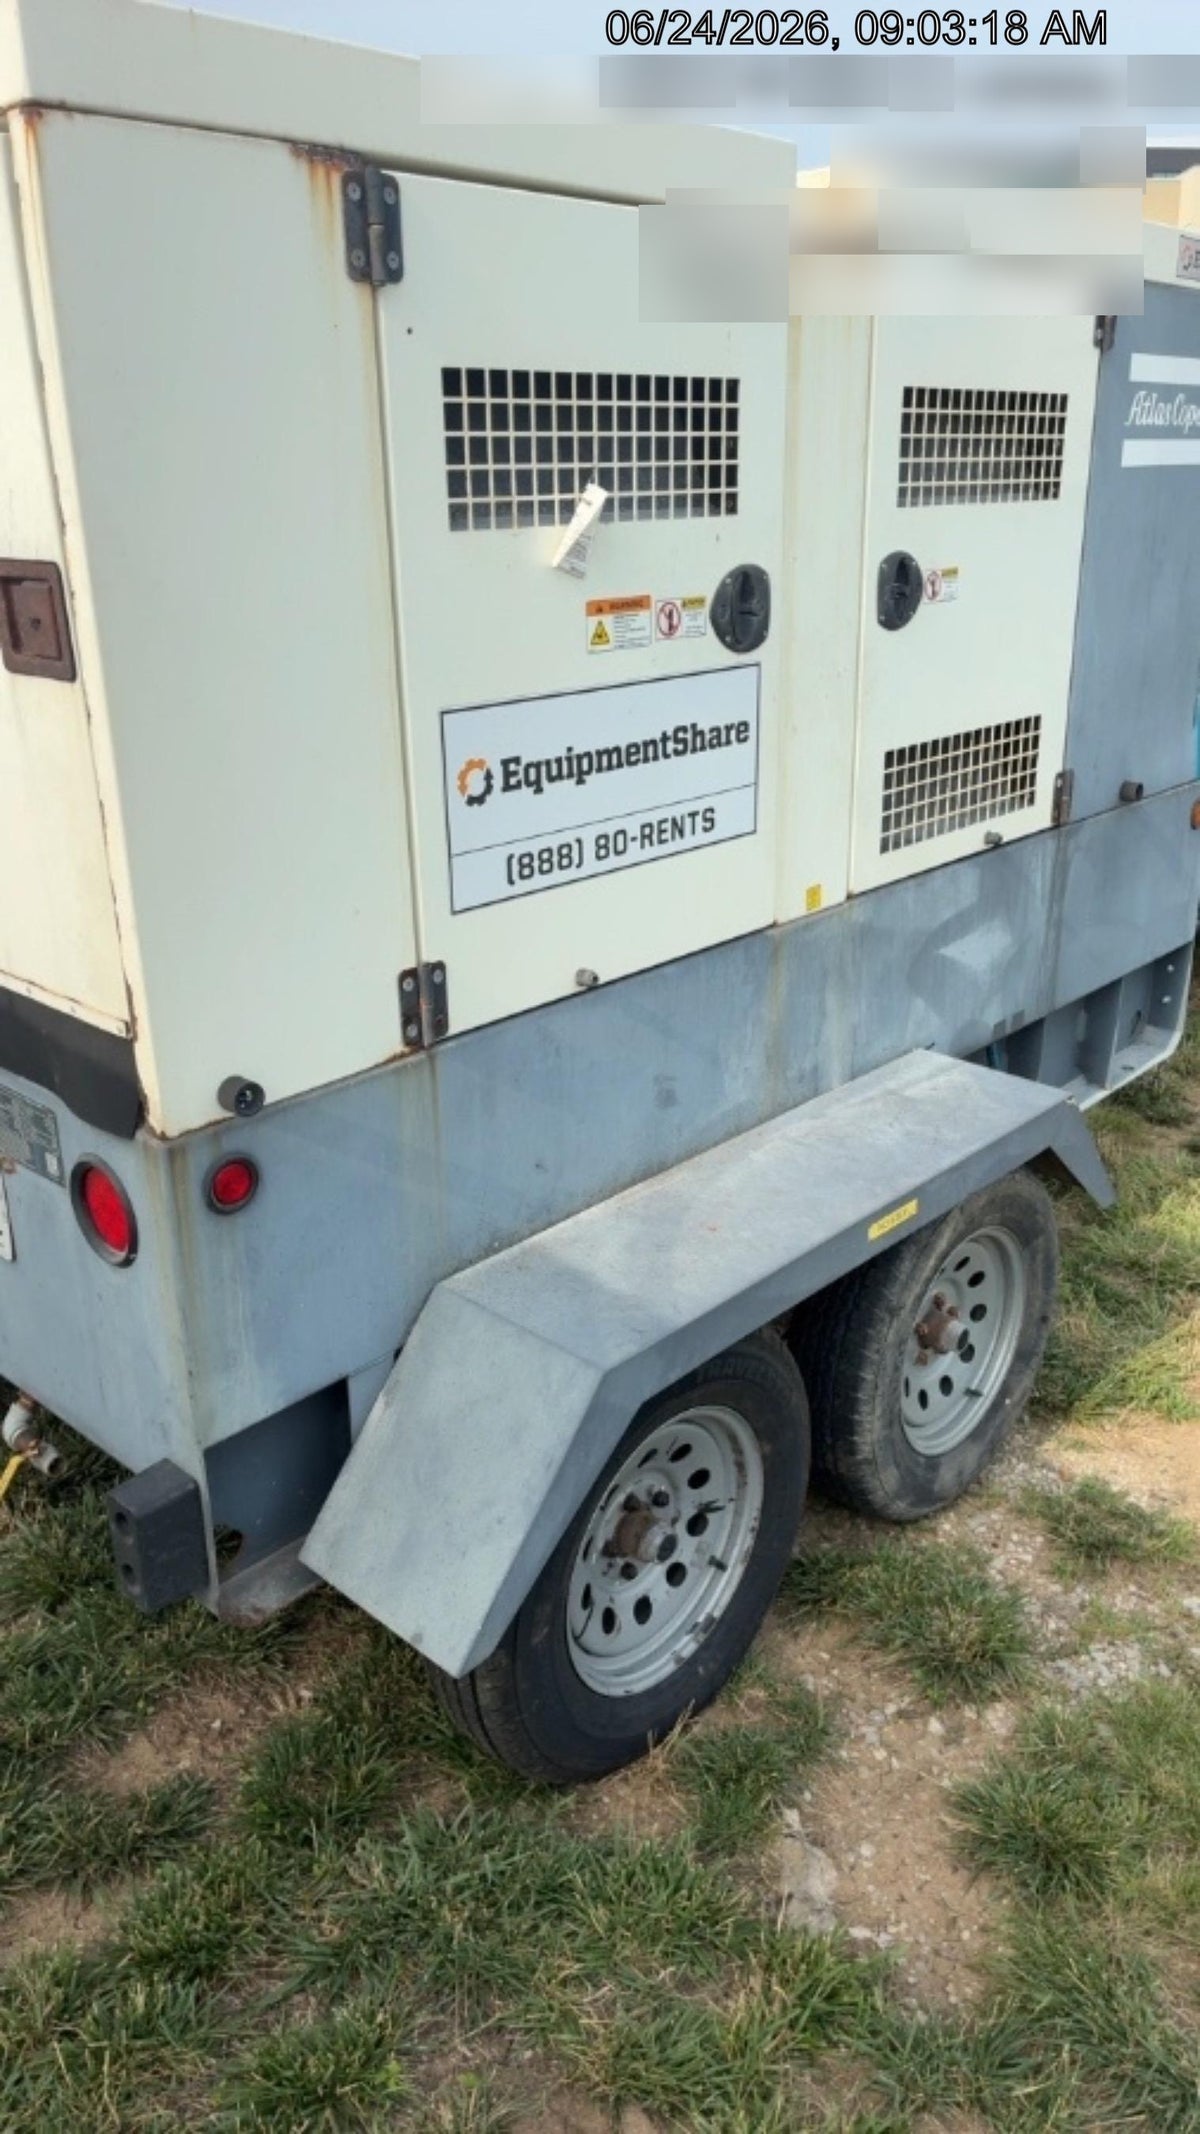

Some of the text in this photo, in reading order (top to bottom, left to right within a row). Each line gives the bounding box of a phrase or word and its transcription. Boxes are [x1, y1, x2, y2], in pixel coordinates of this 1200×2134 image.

[1124, 390, 1172, 426] Atlas
[501, 720, 750, 795] EquipmentShare
[506, 807, 716, 886] (888) 80-RENTS
